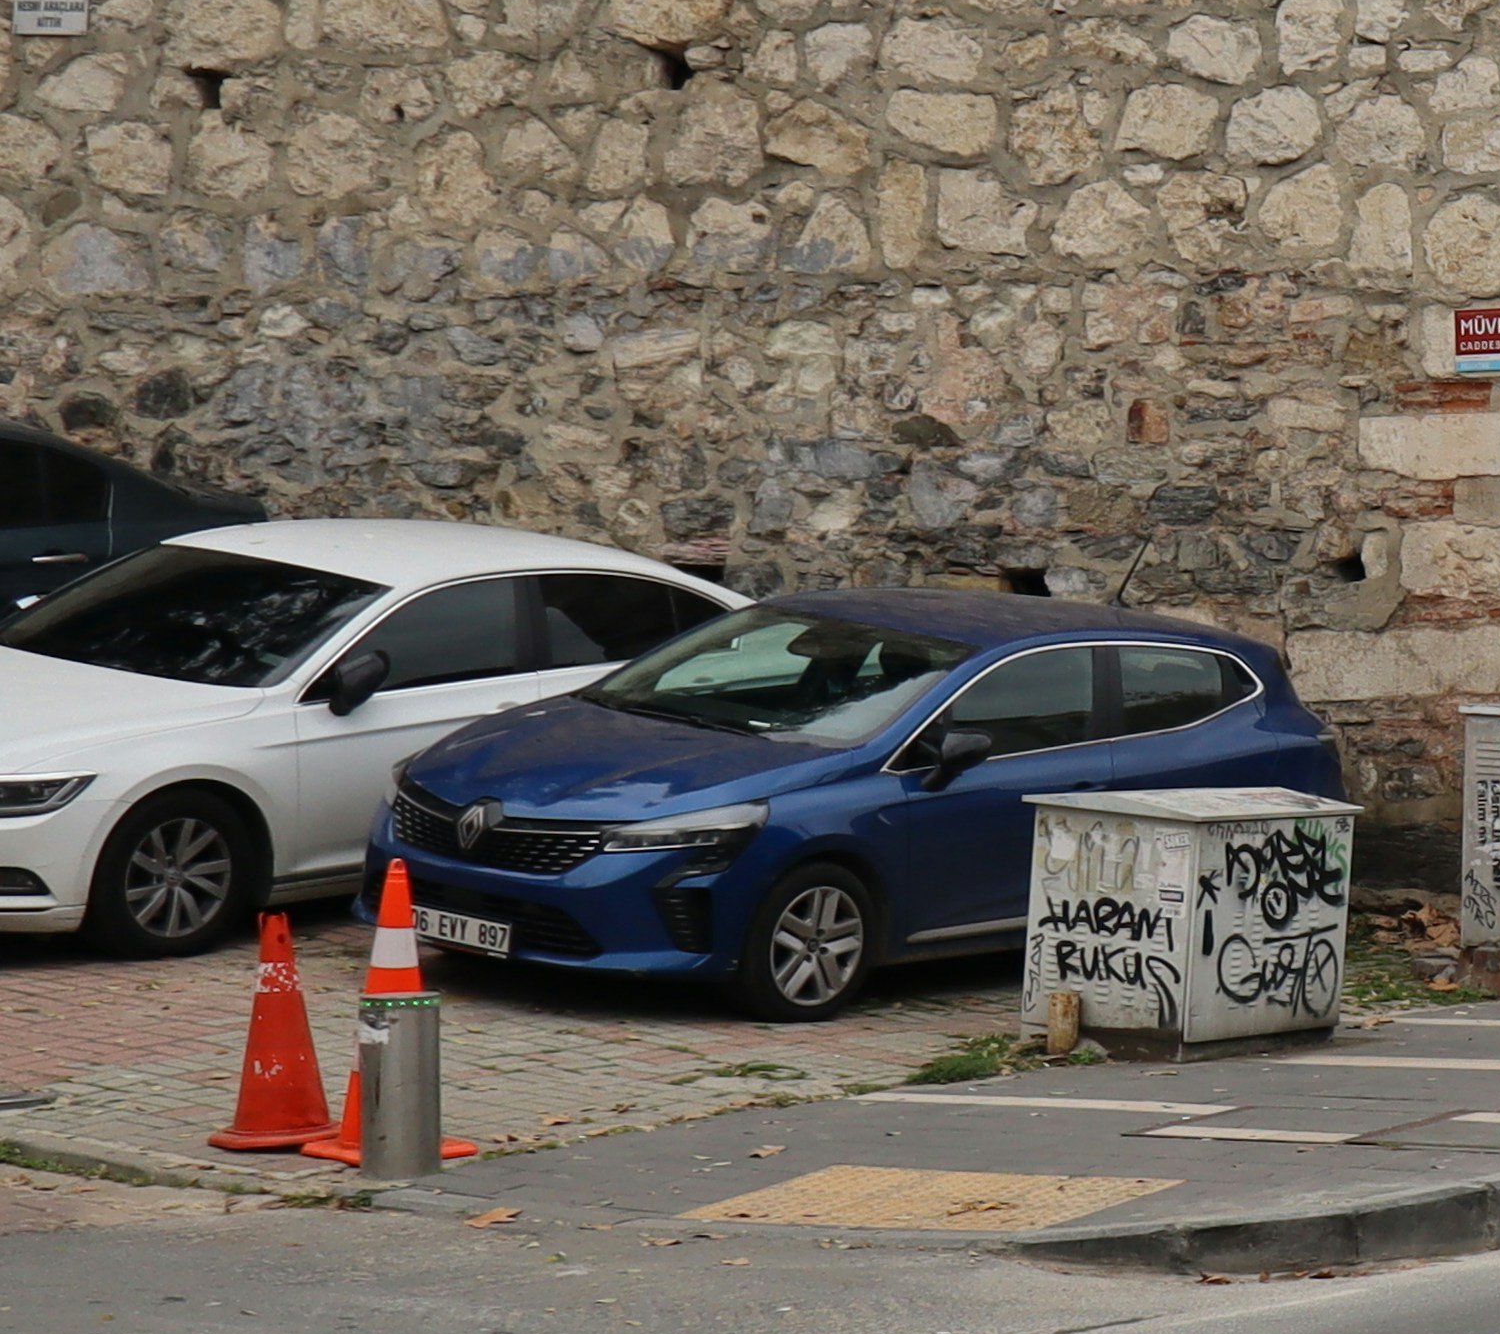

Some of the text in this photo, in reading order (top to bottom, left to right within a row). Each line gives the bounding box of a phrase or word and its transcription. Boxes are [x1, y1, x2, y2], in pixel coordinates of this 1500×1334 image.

[438, 914, 468, 941] EVY
[478, 923, 507, 949] 897
[1039, 896, 1174, 953] HARAM
